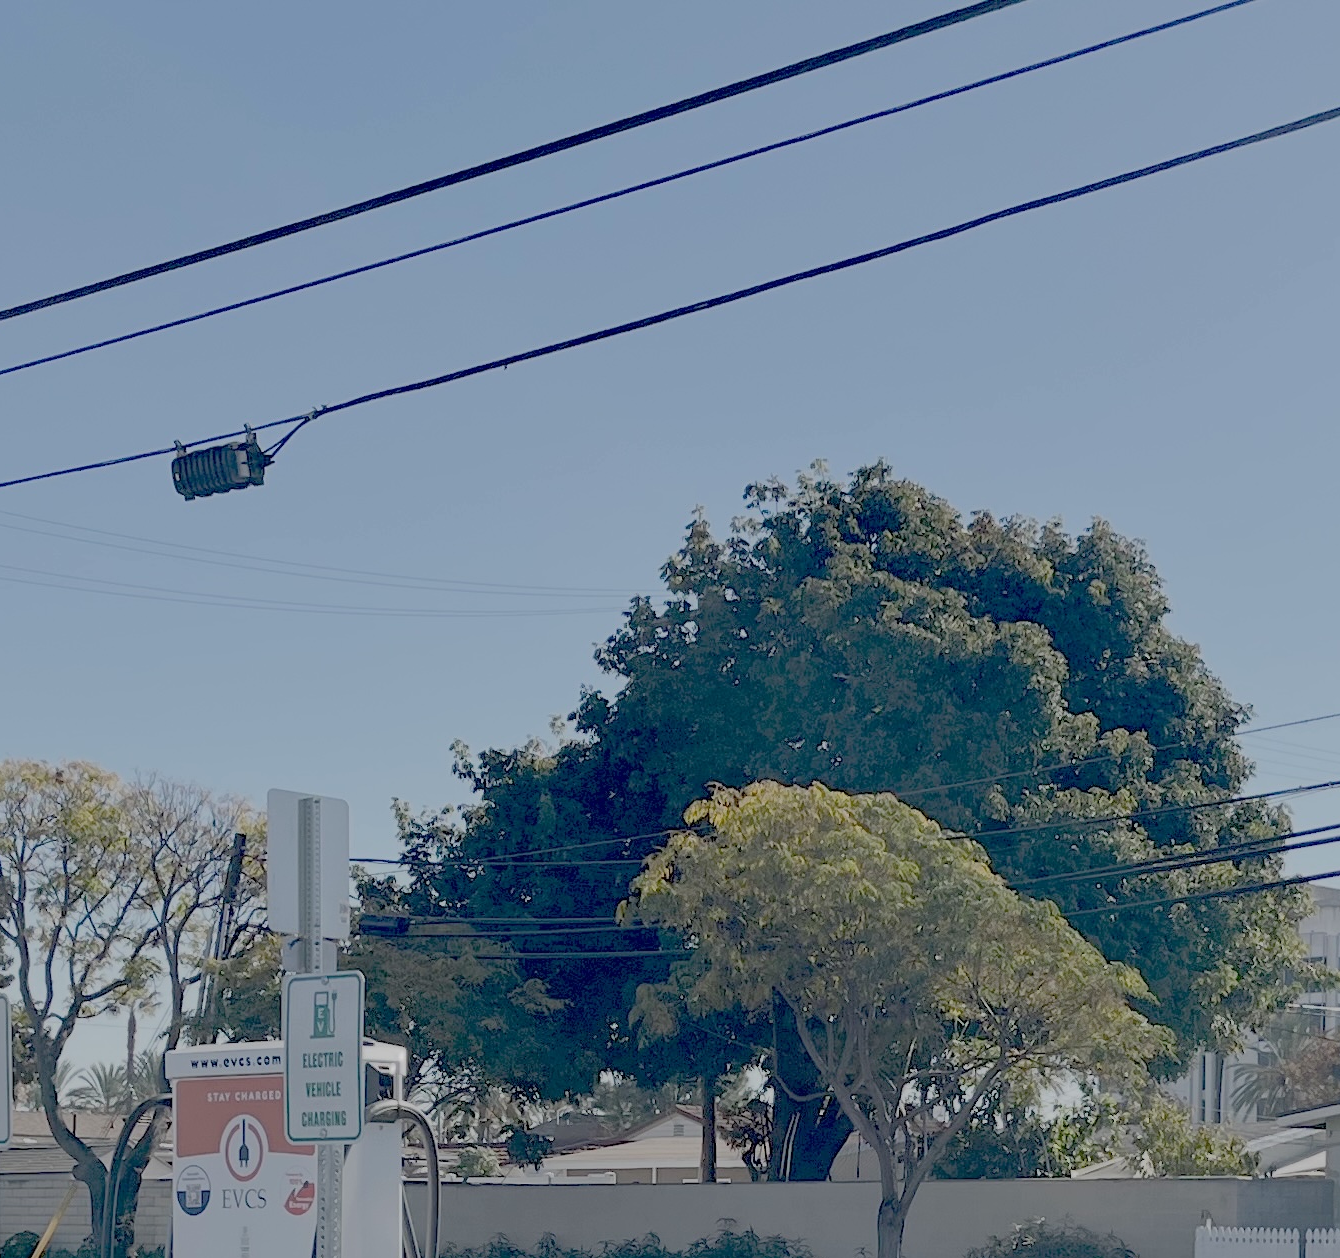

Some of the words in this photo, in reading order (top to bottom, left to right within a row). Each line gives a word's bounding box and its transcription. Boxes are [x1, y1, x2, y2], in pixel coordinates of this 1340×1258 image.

[302, 1051, 344, 1069] ELECTRIC
[206, 1092, 233, 1102] STAY
[235, 1090, 282, 1102] CHARGED
[305, 1081, 342, 1098] VEHICLE
[301, 1110, 347, 1128] CHARGING
[222, 1188, 267, 1209] EVCS
